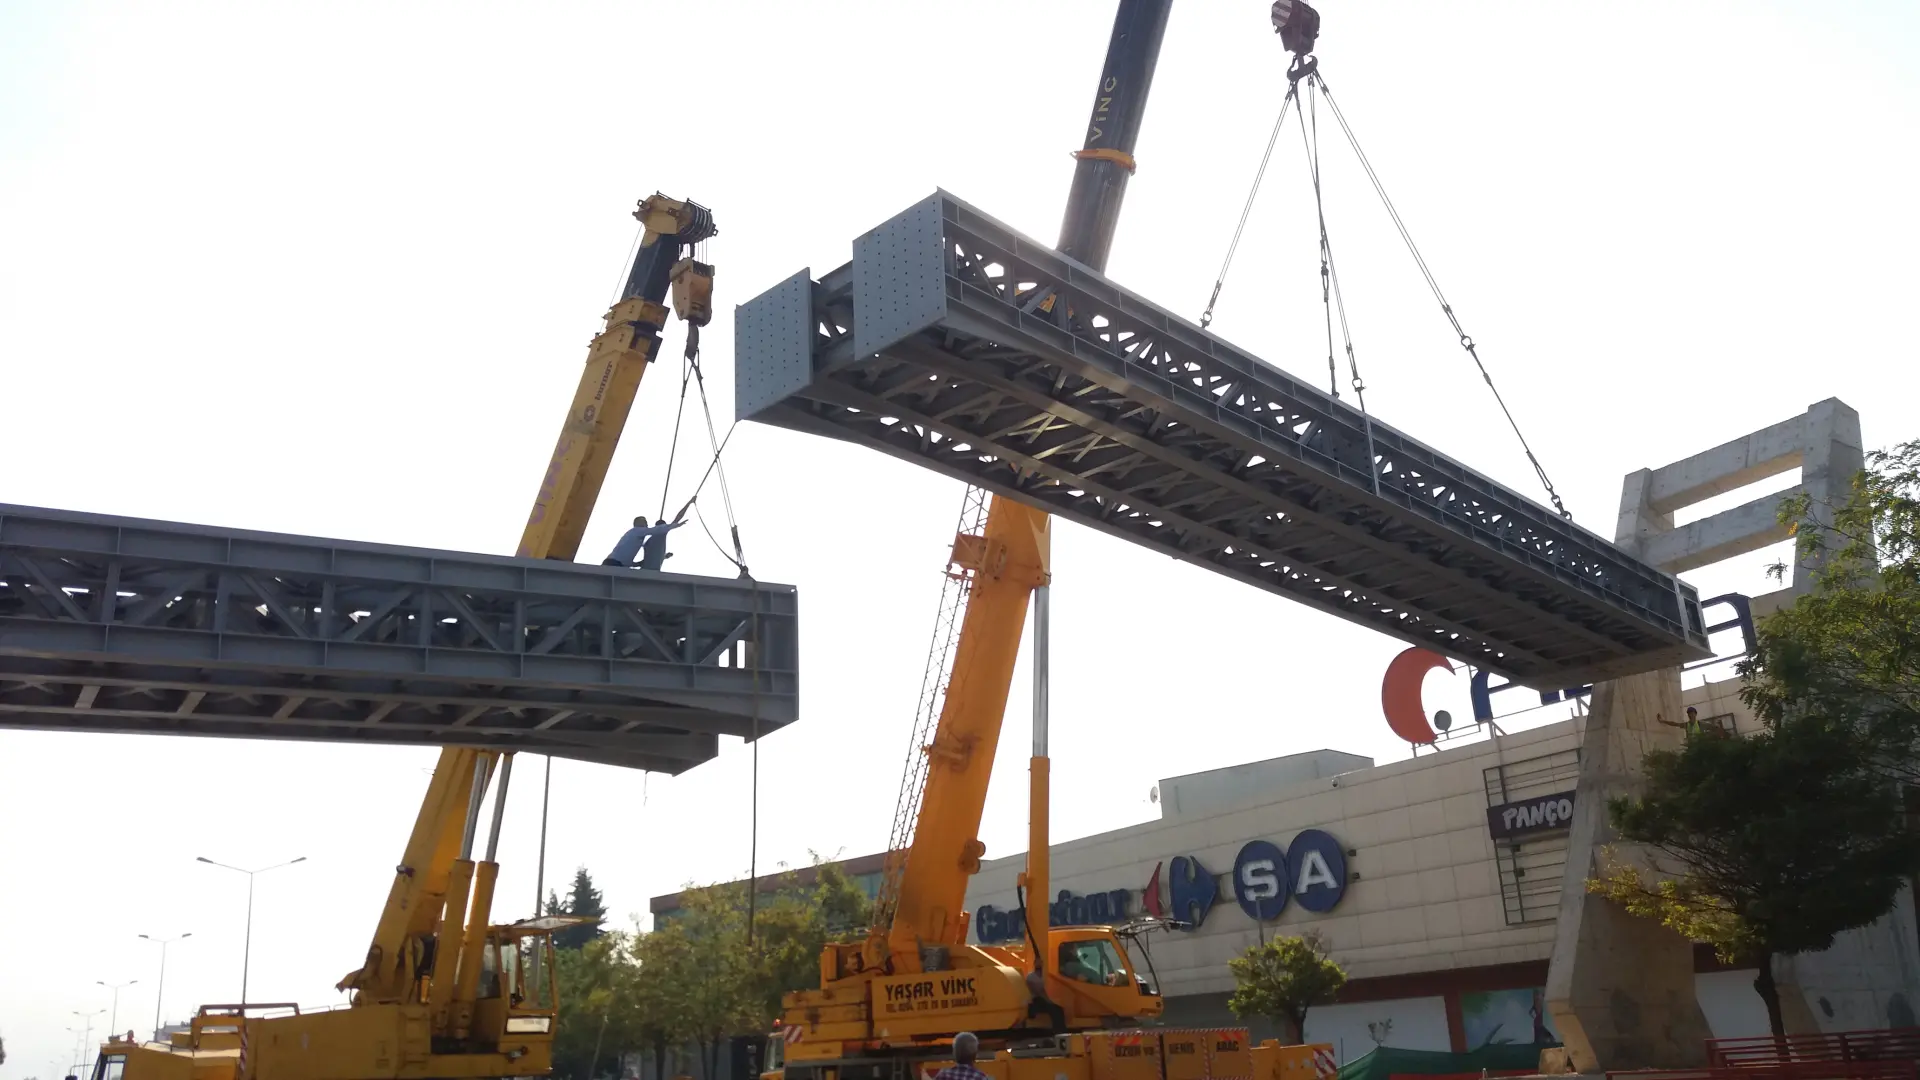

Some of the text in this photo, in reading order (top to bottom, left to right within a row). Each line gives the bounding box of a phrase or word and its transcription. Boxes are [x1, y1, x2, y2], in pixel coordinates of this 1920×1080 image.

[976, 888, 1129, 943] Carfour
[885, 976, 976, 1001] YAŞAR VİNÇ
